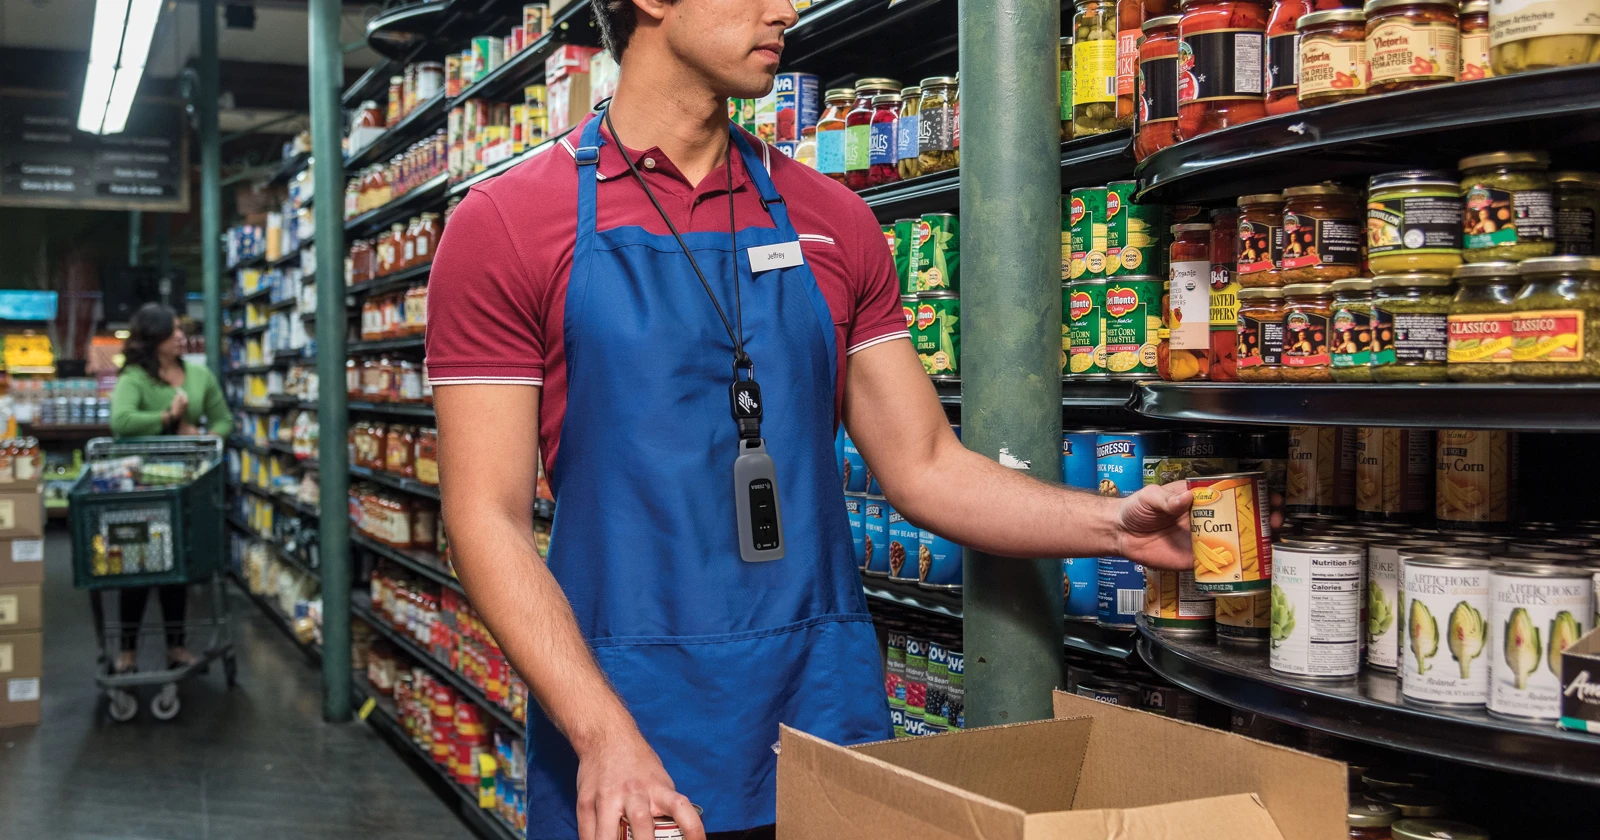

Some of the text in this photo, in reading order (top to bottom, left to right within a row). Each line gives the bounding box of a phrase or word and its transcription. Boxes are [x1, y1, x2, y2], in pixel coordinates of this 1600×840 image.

[1512, 12, 1555, 24] Artichoke
[1374, 36, 1409, 50] Victoria
[1387, 52, 1412, 60] DRIED
[1372, 58, 1412, 70] TOMATOES
[1311, 67, 1334, 76] DRIED
[1371, 210, 1400, 225] BOUILLON
[767, 252, 785, 260] Jeffrey
[1211, 269, 1228, 284] B&G
[1113, 296, 1136, 305] Monte
[1210, 294, 1235, 306] OASTED
[1076, 330, 1090, 338] CORN
[1118, 327, 1136, 335] CORN
[1450, 322, 1499, 334] CLASSICO
[1291, 448, 1312, 460] Corn
[1358, 452, 1378, 465] Corn
[1107, 464, 1123, 473] PEAS
[1454, 458, 1484, 472] Corn
[1194, 491, 1213, 501] oland
[1193, 510, 1213, 518] WHOLE
[1203, 519, 1233, 533] Corn
[901, 530, 918, 539] BEANS
[1412, 573, 1480, 587] ARTICHOKE
[1406, 581, 1445, 595] HEARTS
[1507, 583, 1581, 596] ARTICHOKE
[1497, 592, 1546, 605] HEARTS
[906, 640, 929, 655] GOY
[909, 668, 924, 678] Kidney
